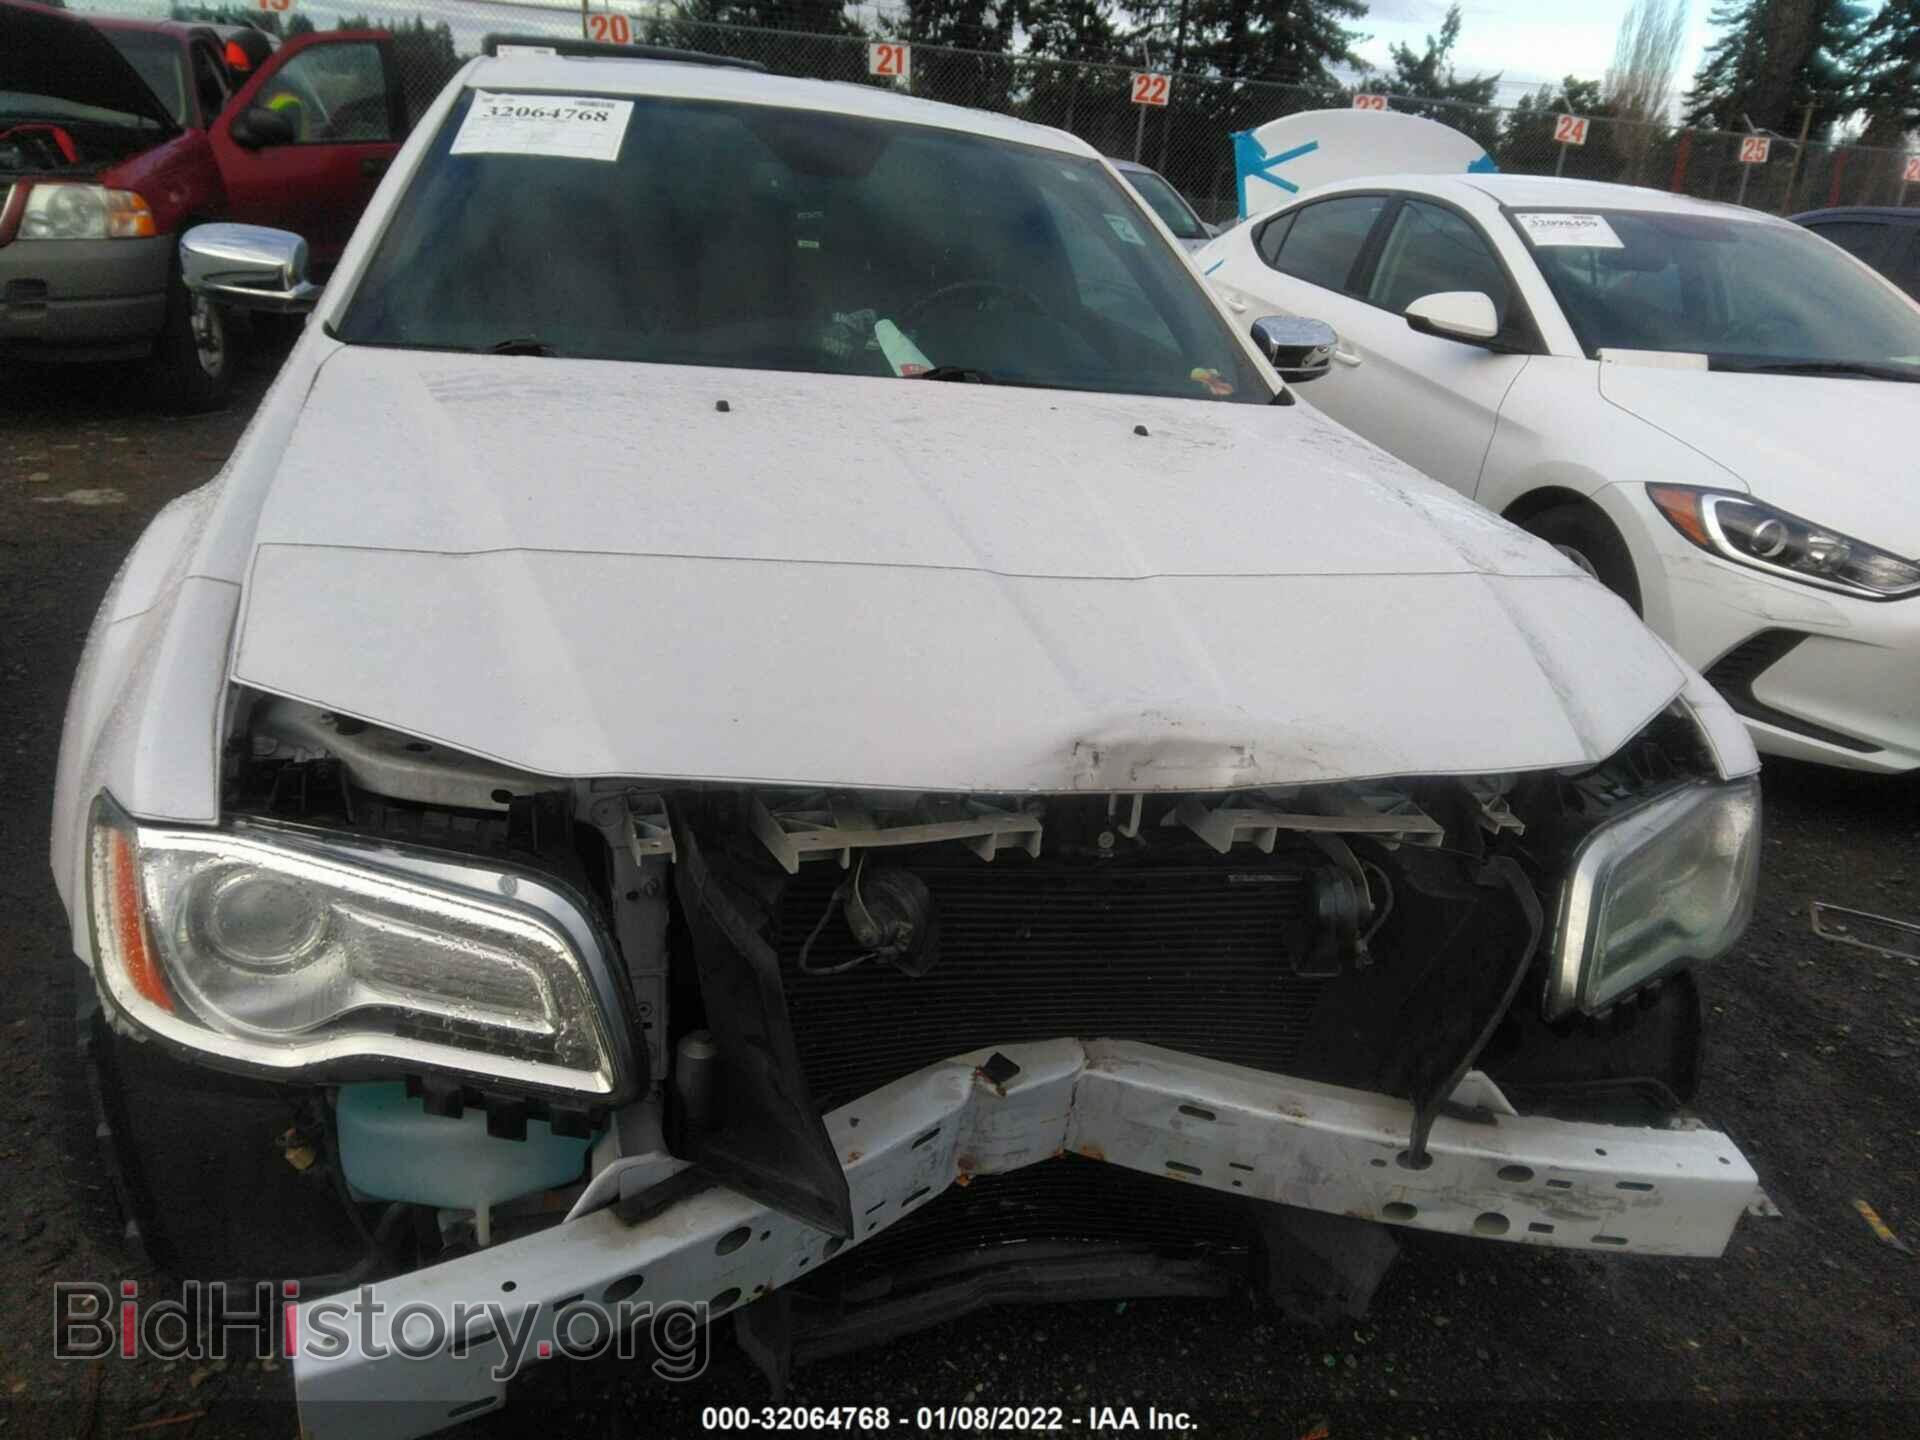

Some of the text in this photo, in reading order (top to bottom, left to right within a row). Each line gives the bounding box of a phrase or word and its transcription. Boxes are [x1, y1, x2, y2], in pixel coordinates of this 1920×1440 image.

[591, 15, 629, 44] 20
[877, 45, 904, 74] 21
[1135, 75, 1167, 103] 22
[483, 105, 610, 122] 32064768
[1557, 115, 1585, 142] 24
[1743, 138, 1766, 161] 25
